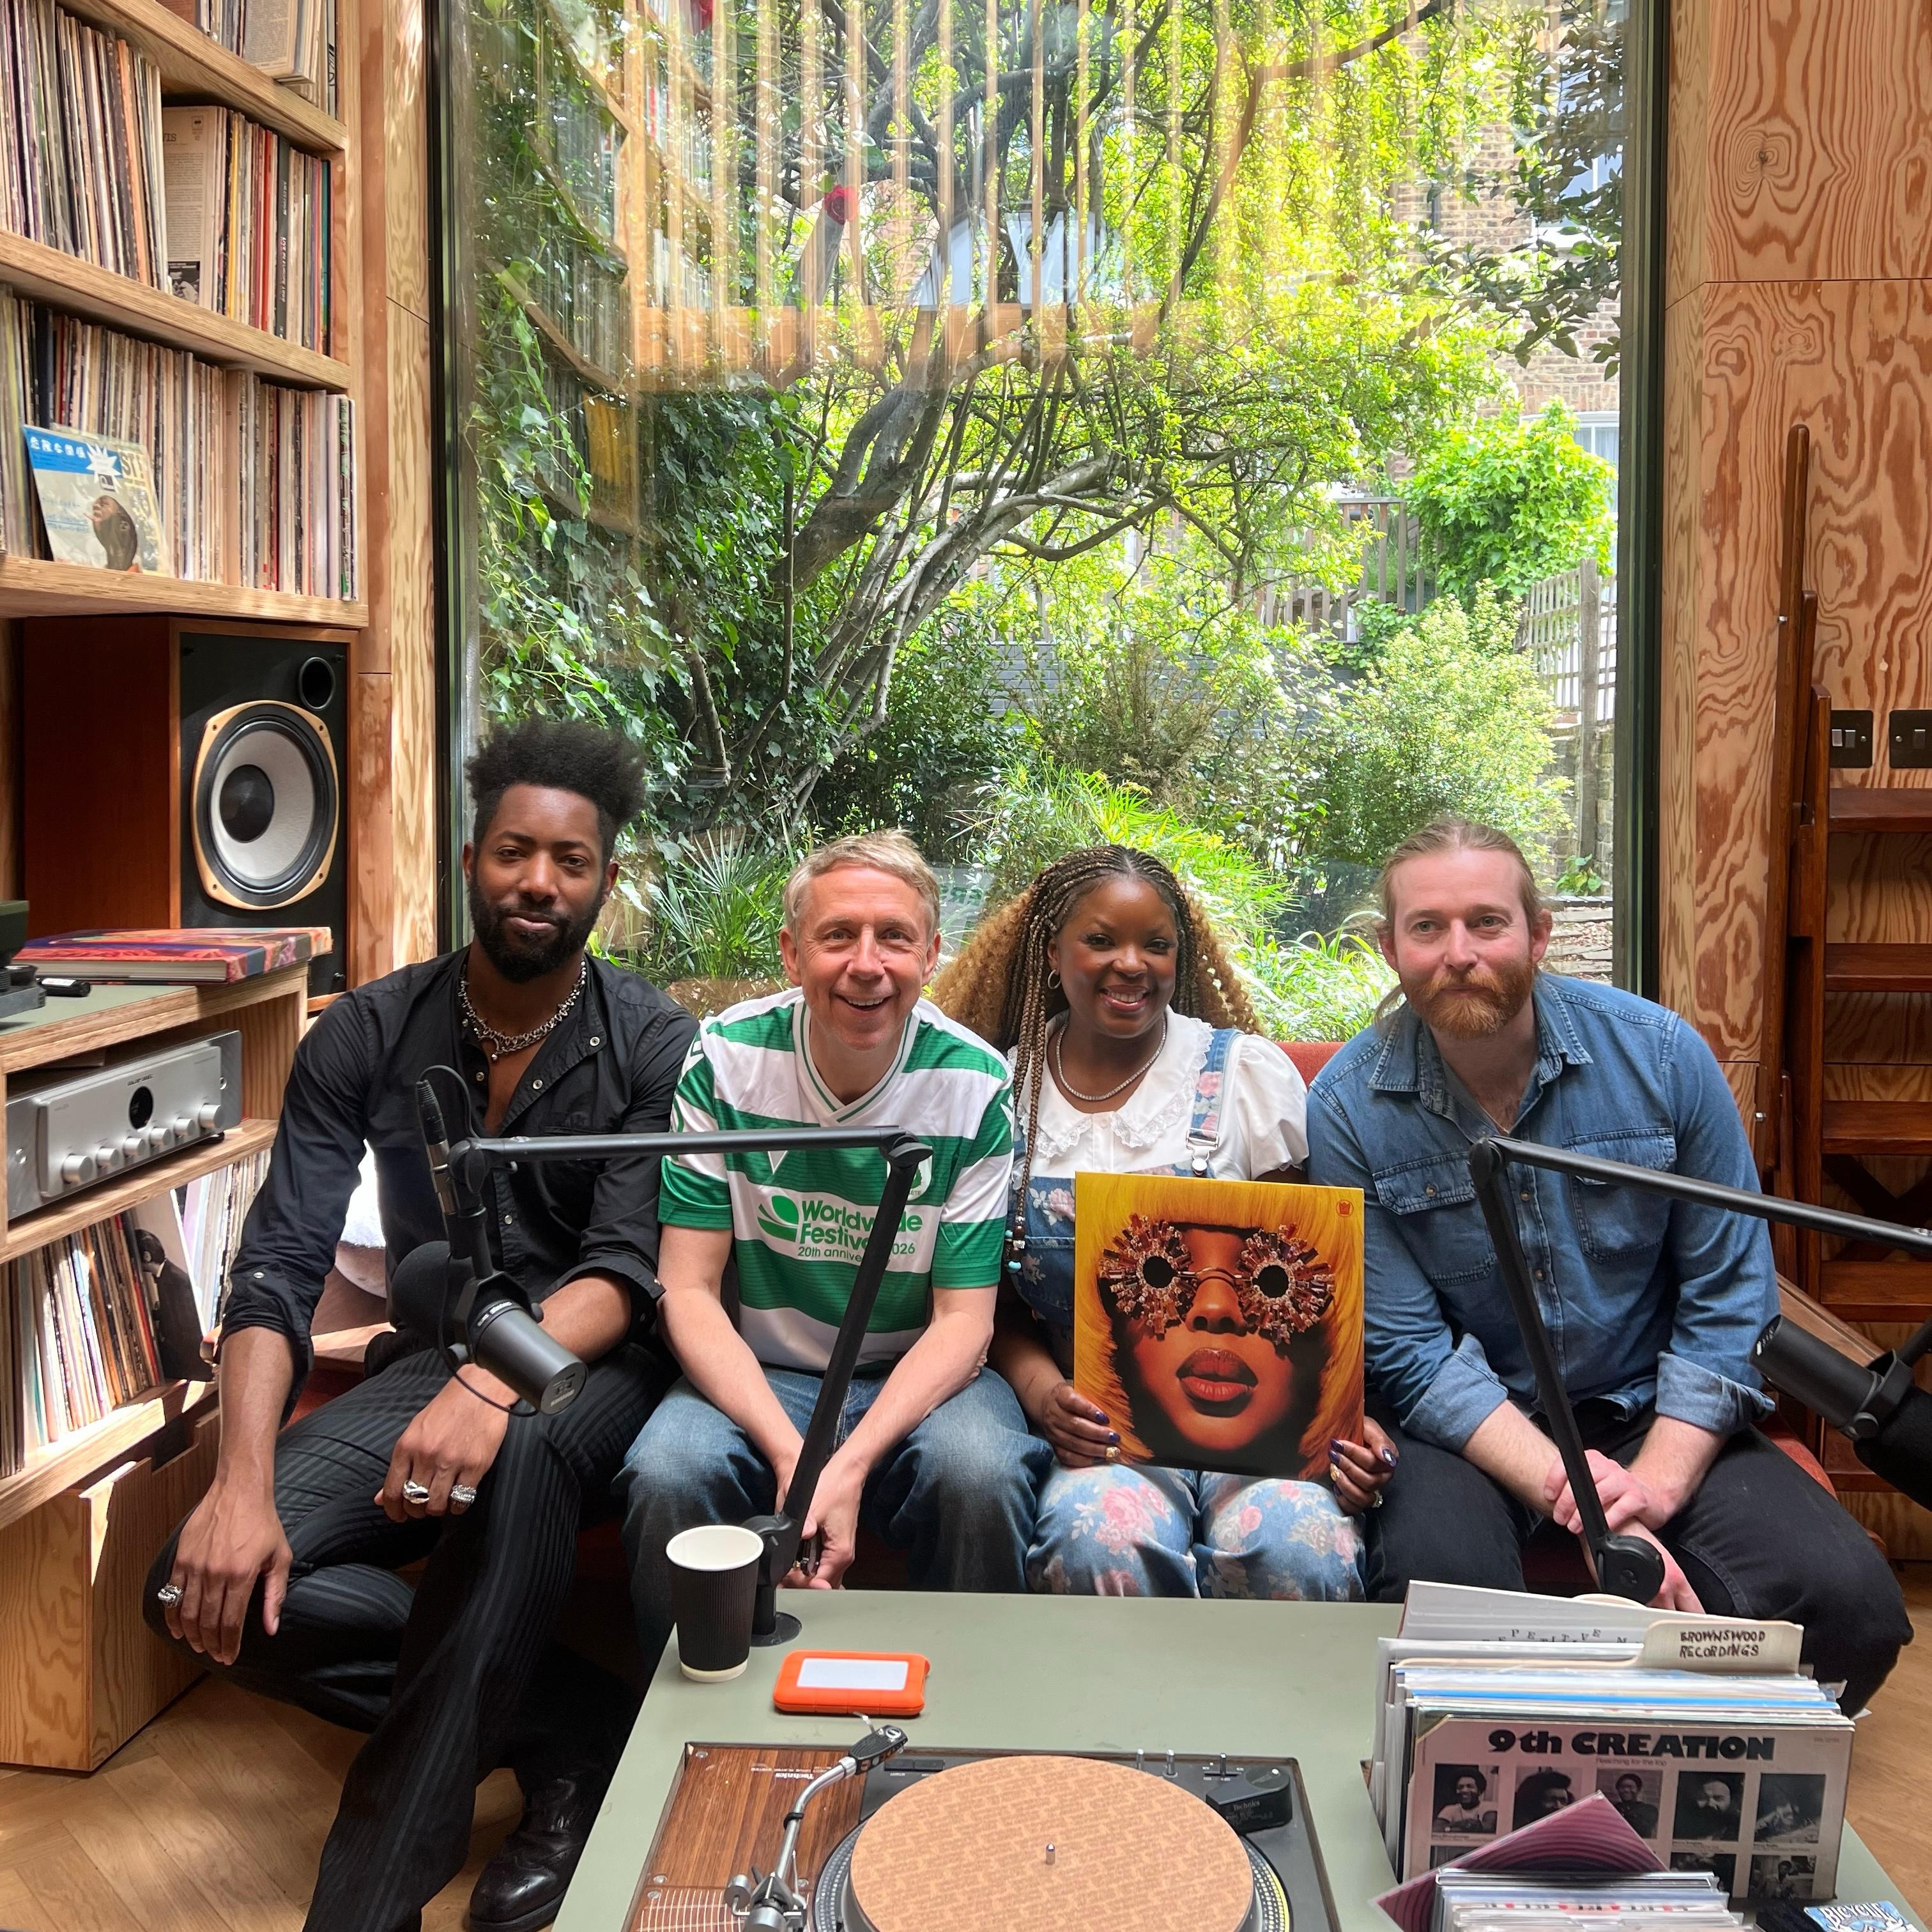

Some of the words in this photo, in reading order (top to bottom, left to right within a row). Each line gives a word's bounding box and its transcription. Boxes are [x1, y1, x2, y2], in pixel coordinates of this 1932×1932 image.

[802, 1200, 923, 1232] Worldwde
[797, 1246, 821, 1257] 20th
[892, 1243, 916, 1255] 026
[800, 1223, 870, 1251] Festiv
[1680, 1630, 1766, 1643] BROWNSWOOD
[1680, 1643, 1759, 1659] RECORDINGS
[1488, 1729, 1563, 1754] 9th
[1571, 1732, 1775, 1761] CREATION
[1819, 1901, 1896, 1928] BICYCLE
